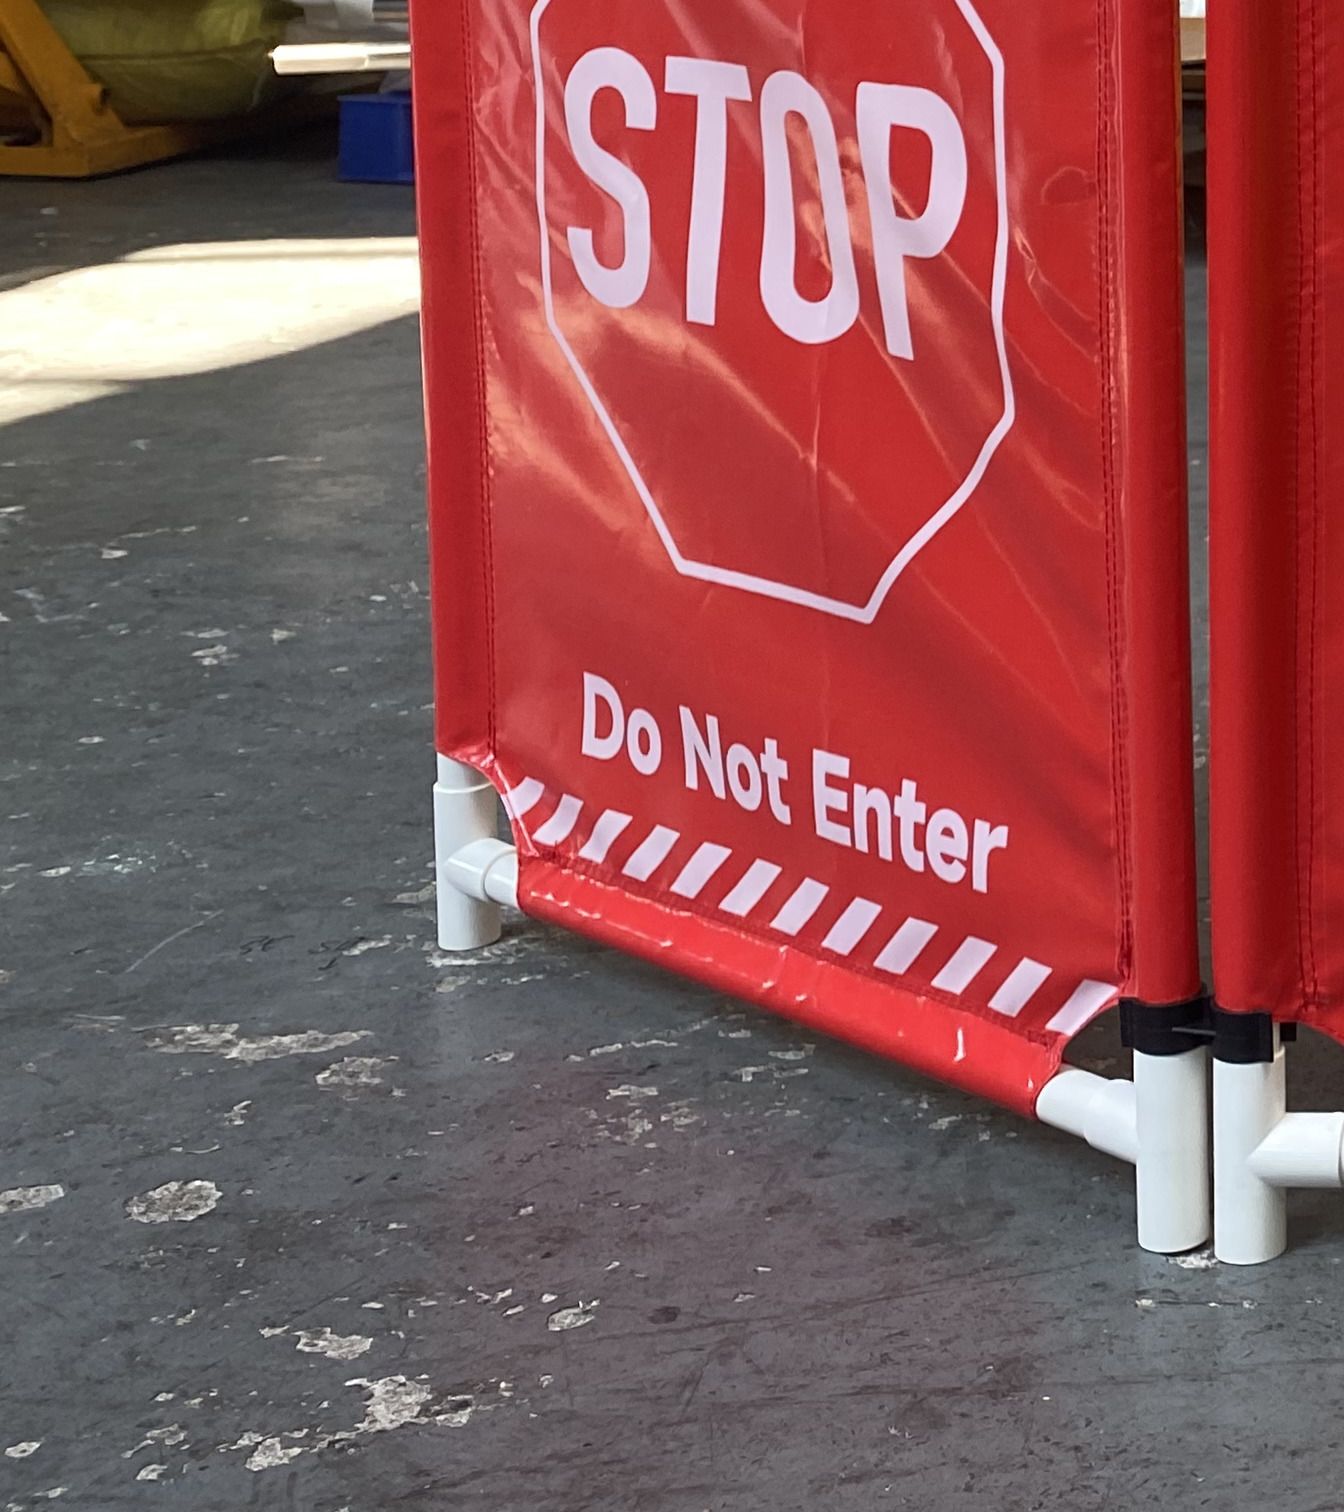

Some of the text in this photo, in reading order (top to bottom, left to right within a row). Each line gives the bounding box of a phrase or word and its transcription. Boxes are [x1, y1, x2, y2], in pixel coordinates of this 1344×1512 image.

[560, 45, 969, 363] STOP
[581, 671, 1009, 894] Do Not Enter
